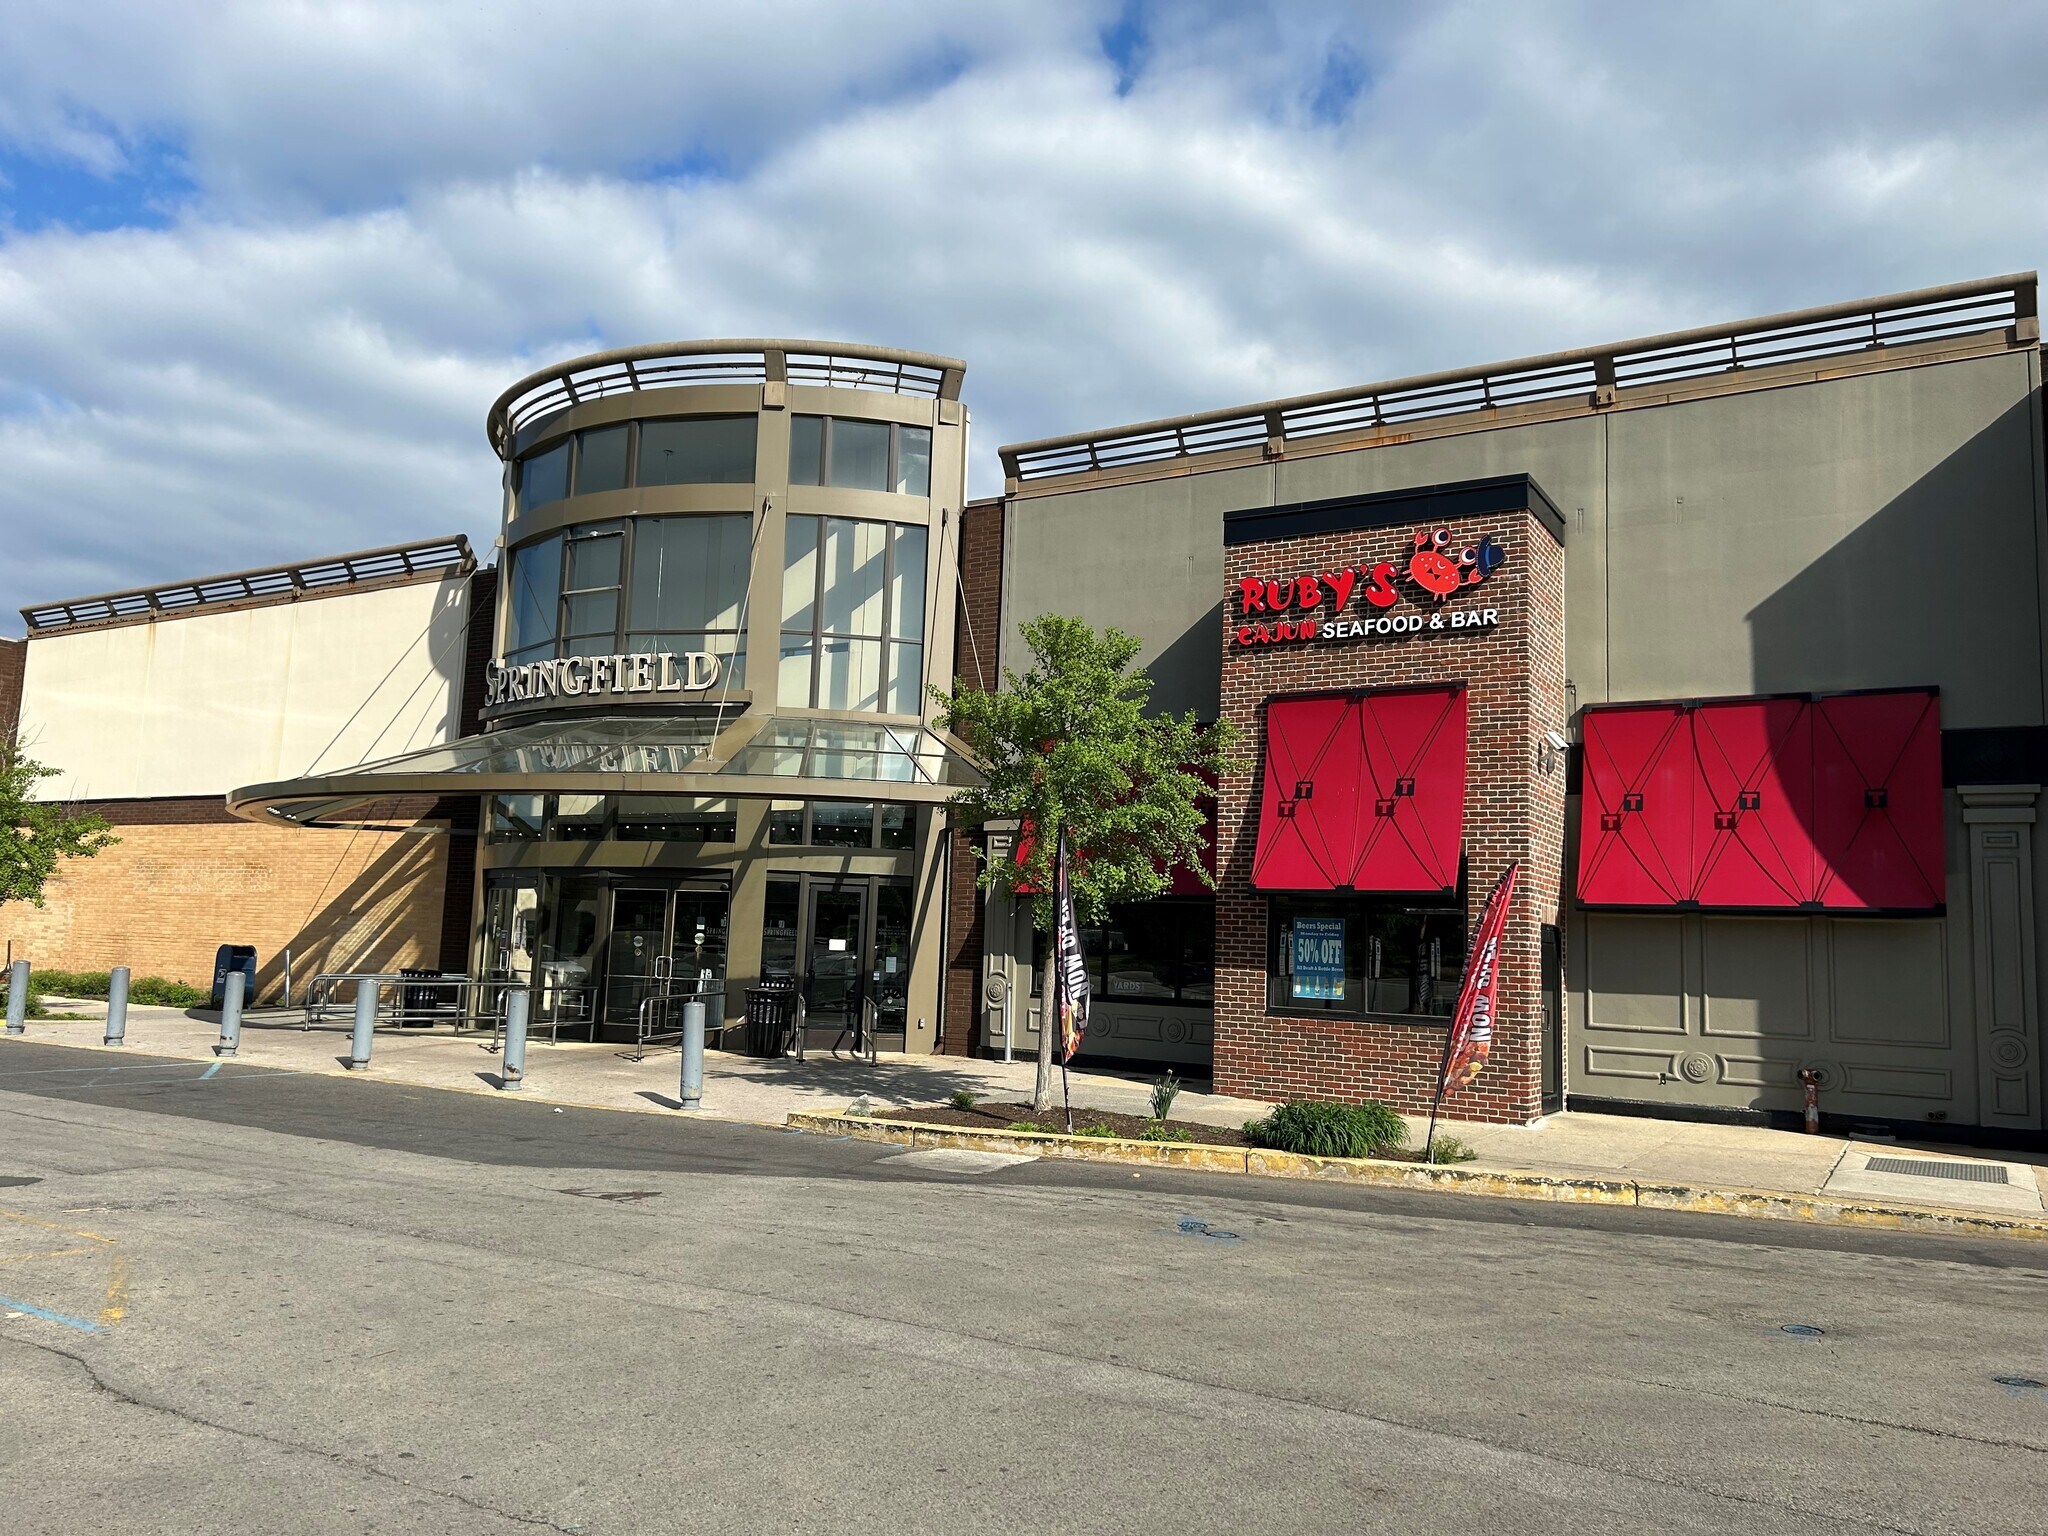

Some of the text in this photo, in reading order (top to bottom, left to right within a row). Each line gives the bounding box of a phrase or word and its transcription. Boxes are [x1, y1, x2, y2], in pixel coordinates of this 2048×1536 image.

[1239, 561, 1399, 614] RUBY'S
[1237, 608, 1499, 646] CAJUN SEAFOOD & BAR
[484, 651, 723, 707] SPRINGFIELD
[1297, 922, 1341, 931] Beers Special
[1298, 938, 1319, 963] 50%
[1321, 939, 1342, 964] OFF
[1064, 953, 1089, 1000] NOW
[1113, 980, 1141, 990] YARDS
[1470, 994, 1492, 1041] NOW
